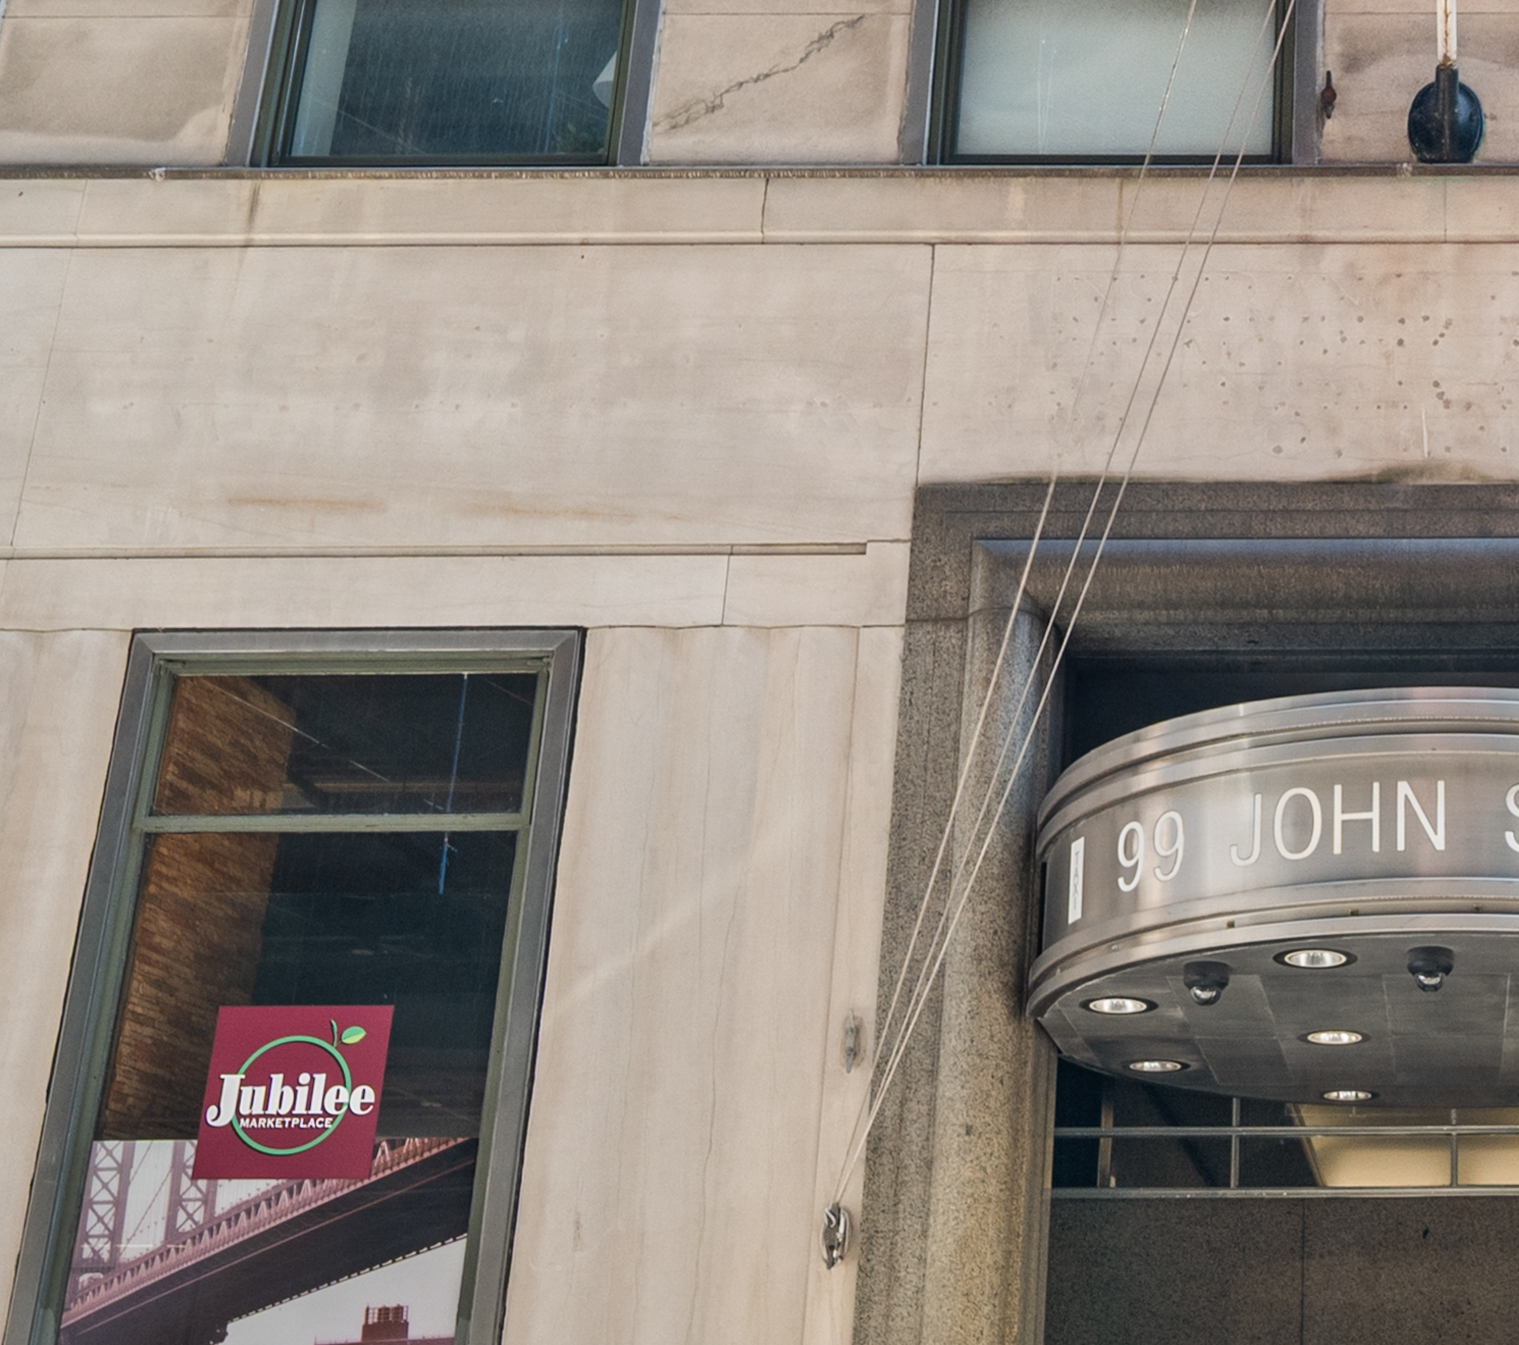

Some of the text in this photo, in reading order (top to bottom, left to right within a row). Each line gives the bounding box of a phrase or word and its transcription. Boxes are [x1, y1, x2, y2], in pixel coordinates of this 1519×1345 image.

[1117, 810, 1184, 893] 99
[1230, 780, 1445, 867] JOHN
[206, 1072, 375, 1127] Jubilee
[239, 1118, 333, 1128] MARKETPLACE
